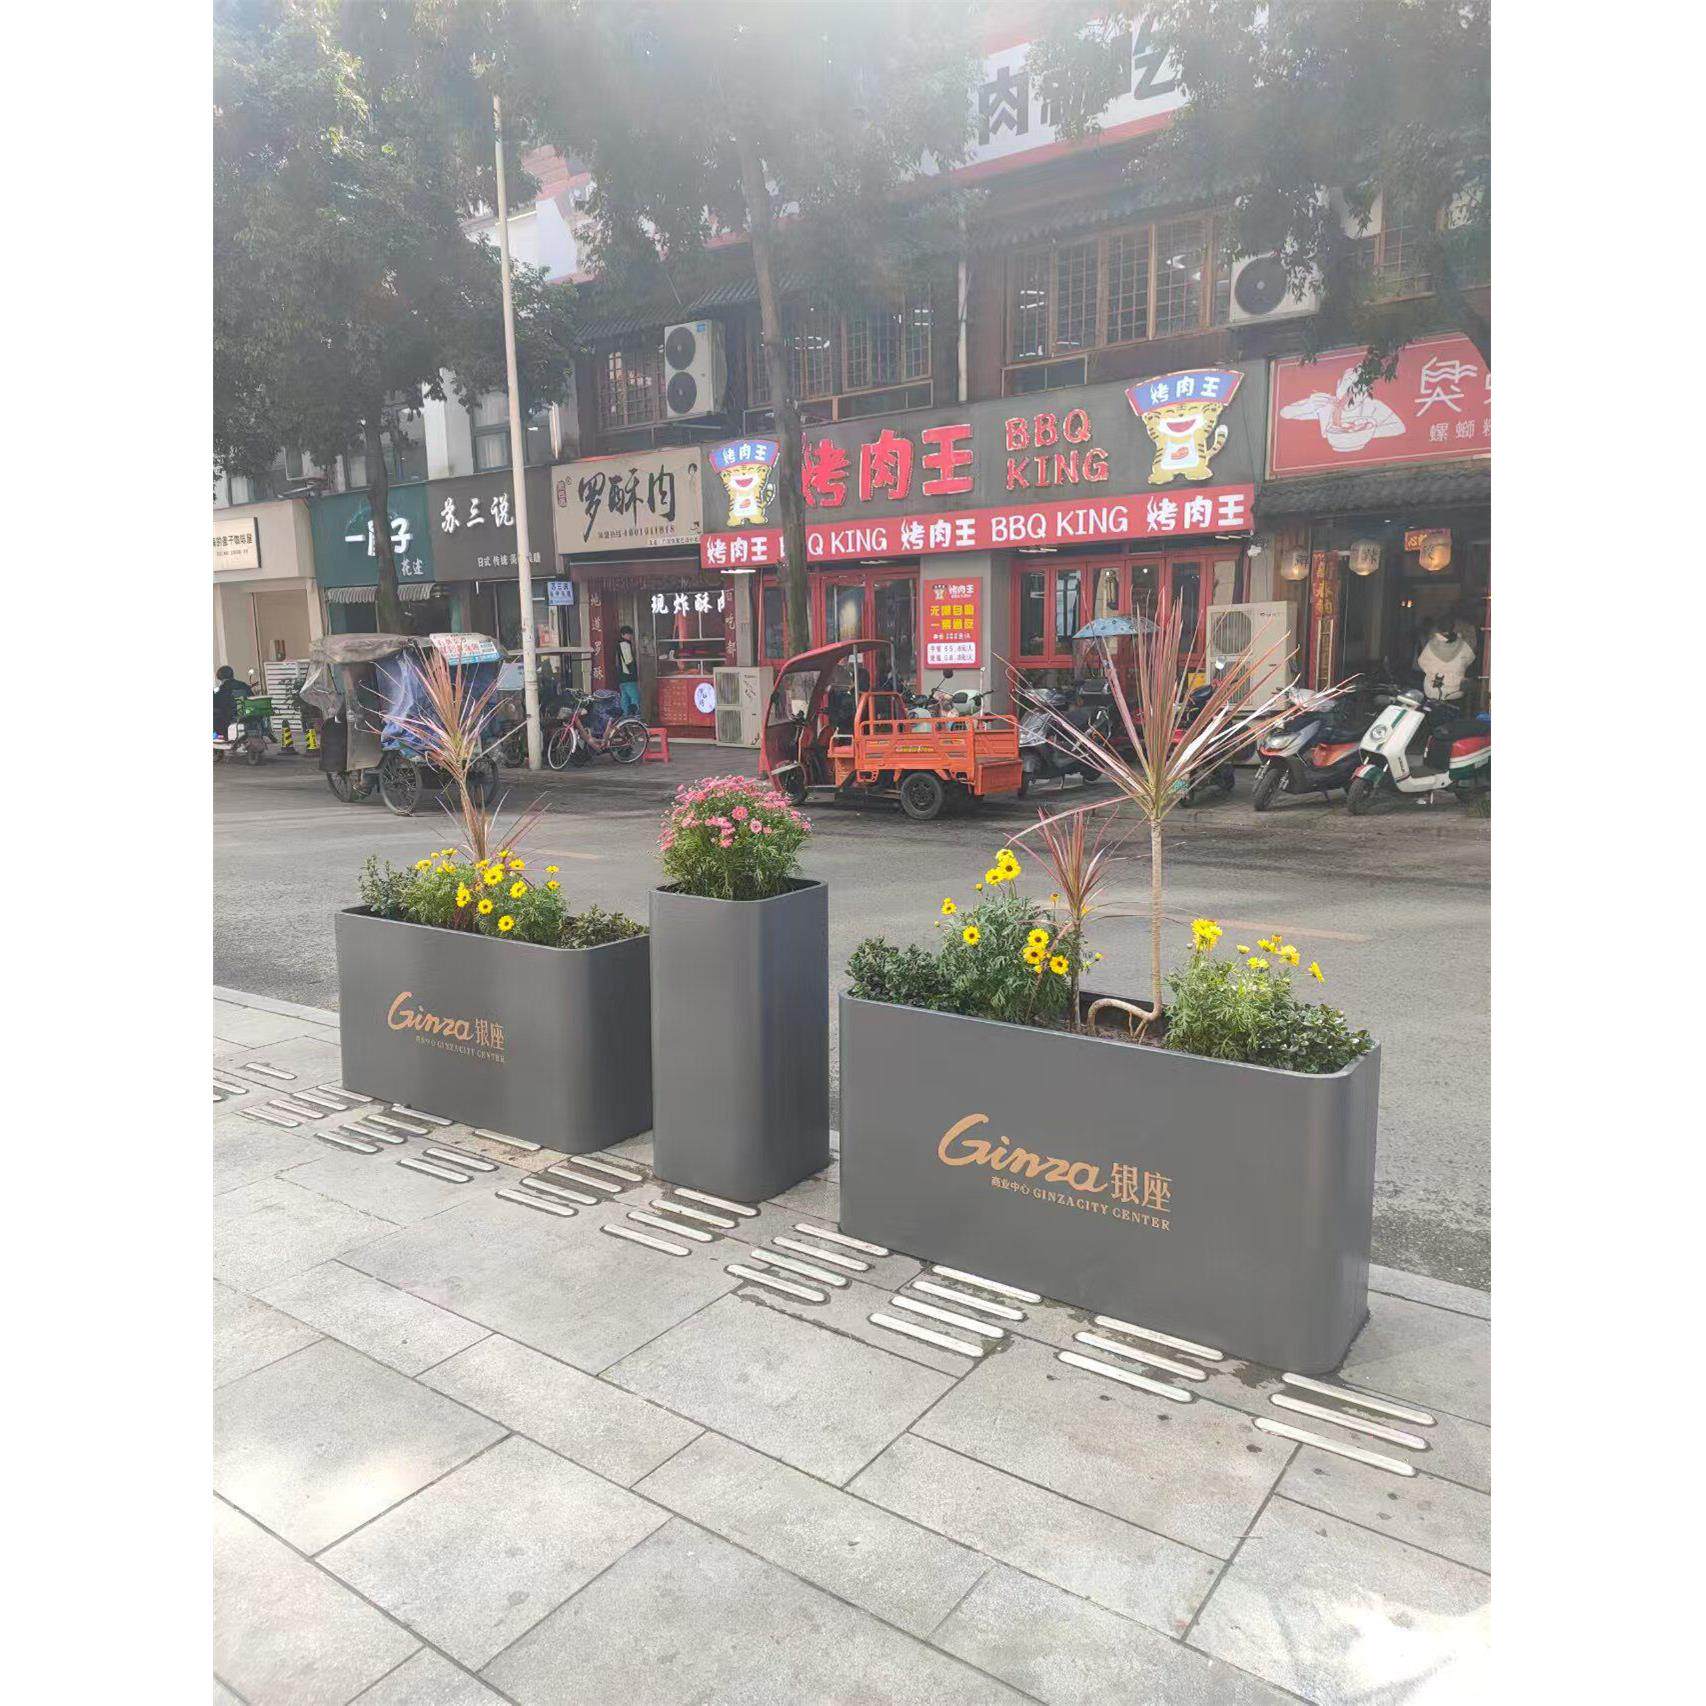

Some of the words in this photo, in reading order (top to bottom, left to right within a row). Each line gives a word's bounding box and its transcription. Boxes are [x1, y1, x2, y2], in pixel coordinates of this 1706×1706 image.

[1150, 375, 1222, 404] 烤肉王
[1004, 408, 1092, 452] BBQ
[722, 443, 768, 464] 烤肉王
[800, 422, 974, 508] 烤肉王
[1006, 447, 1110, 490] KING
[440, 494, 515, 534] 苏三说
[578, 464, 676, 543] 罗酥肉
[1146, 494, 1245, 532] 烤肉王
[345, 517, 413, 556] 一子
[831, 528, 887, 554] KING
[901, 517, 976, 549] 烤肉王
[991, 513, 1047, 542] BBQ
[1056, 505, 1128, 537] KING
[707, 536, 768, 565] 烤肉王
[387, 991, 475, 1041] Ginza
[475, 1018, 505, 1050] 银座
[938, 1113, 1108, 1192] Ginza
[1111, 1162, 1172, 1213] 银座
[991, 1175, 1031, 1195] 商业中心
[1112, 1206, 1171, 1231] CENTER
